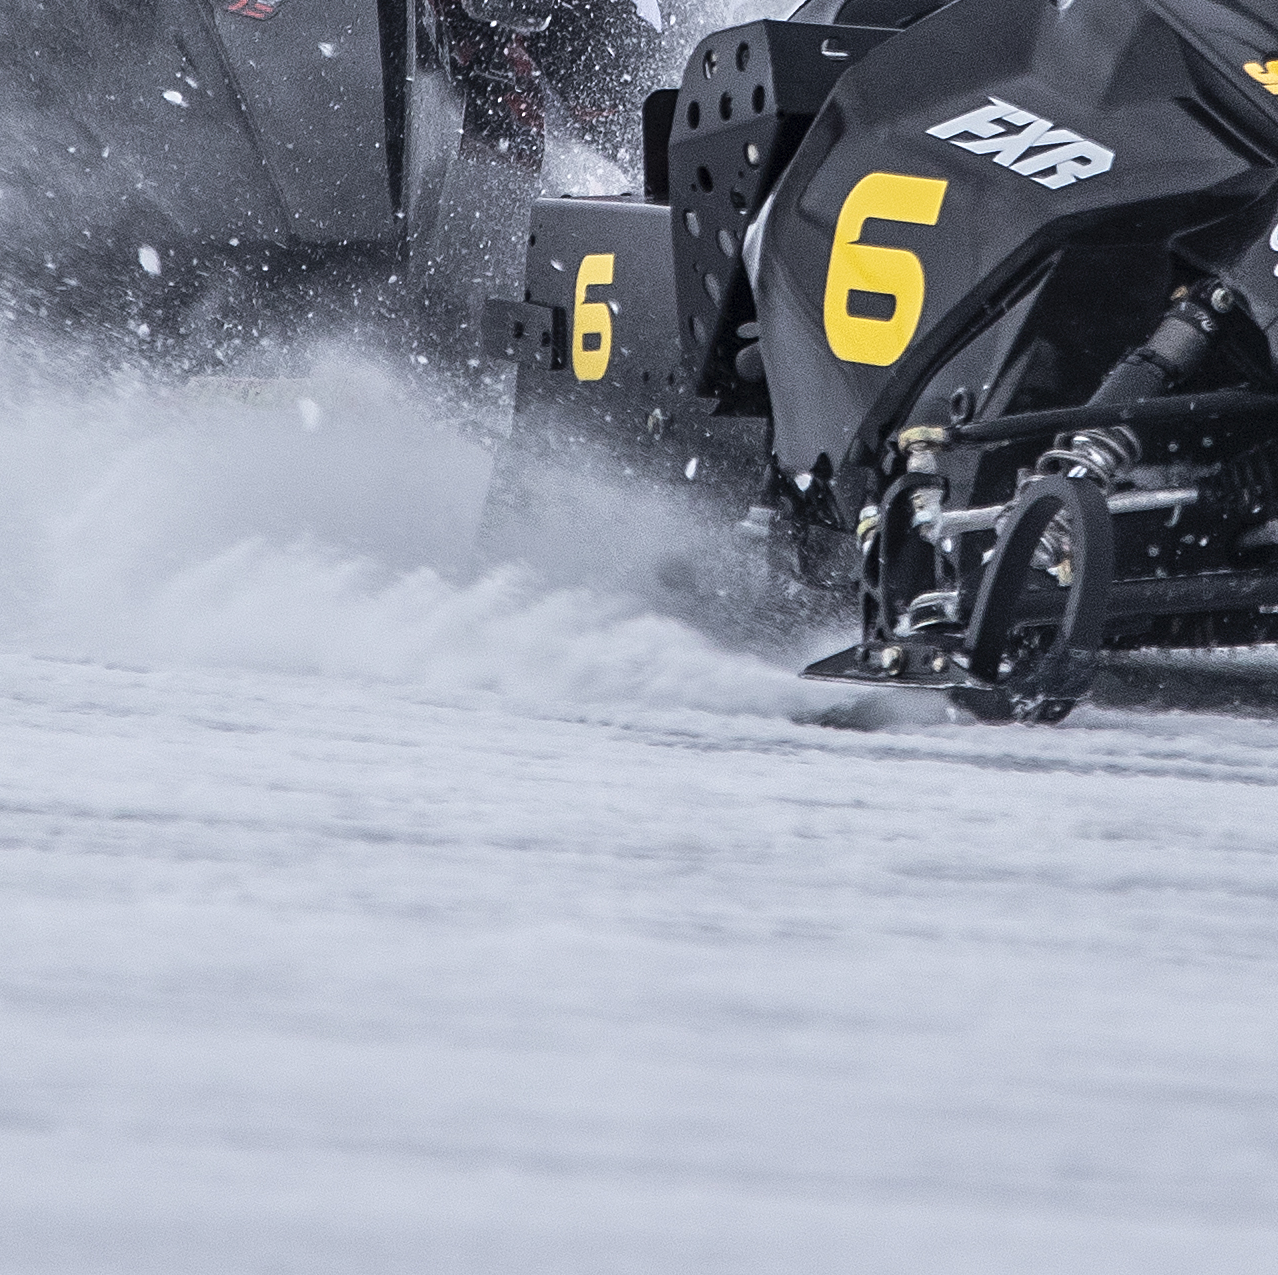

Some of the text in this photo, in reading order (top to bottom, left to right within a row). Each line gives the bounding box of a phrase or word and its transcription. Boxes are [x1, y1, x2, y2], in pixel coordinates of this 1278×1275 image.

[926, 96, 1115, 190] FXR
[571, 253, 615, 381] 6
[824, 172, 947, 367] 6
